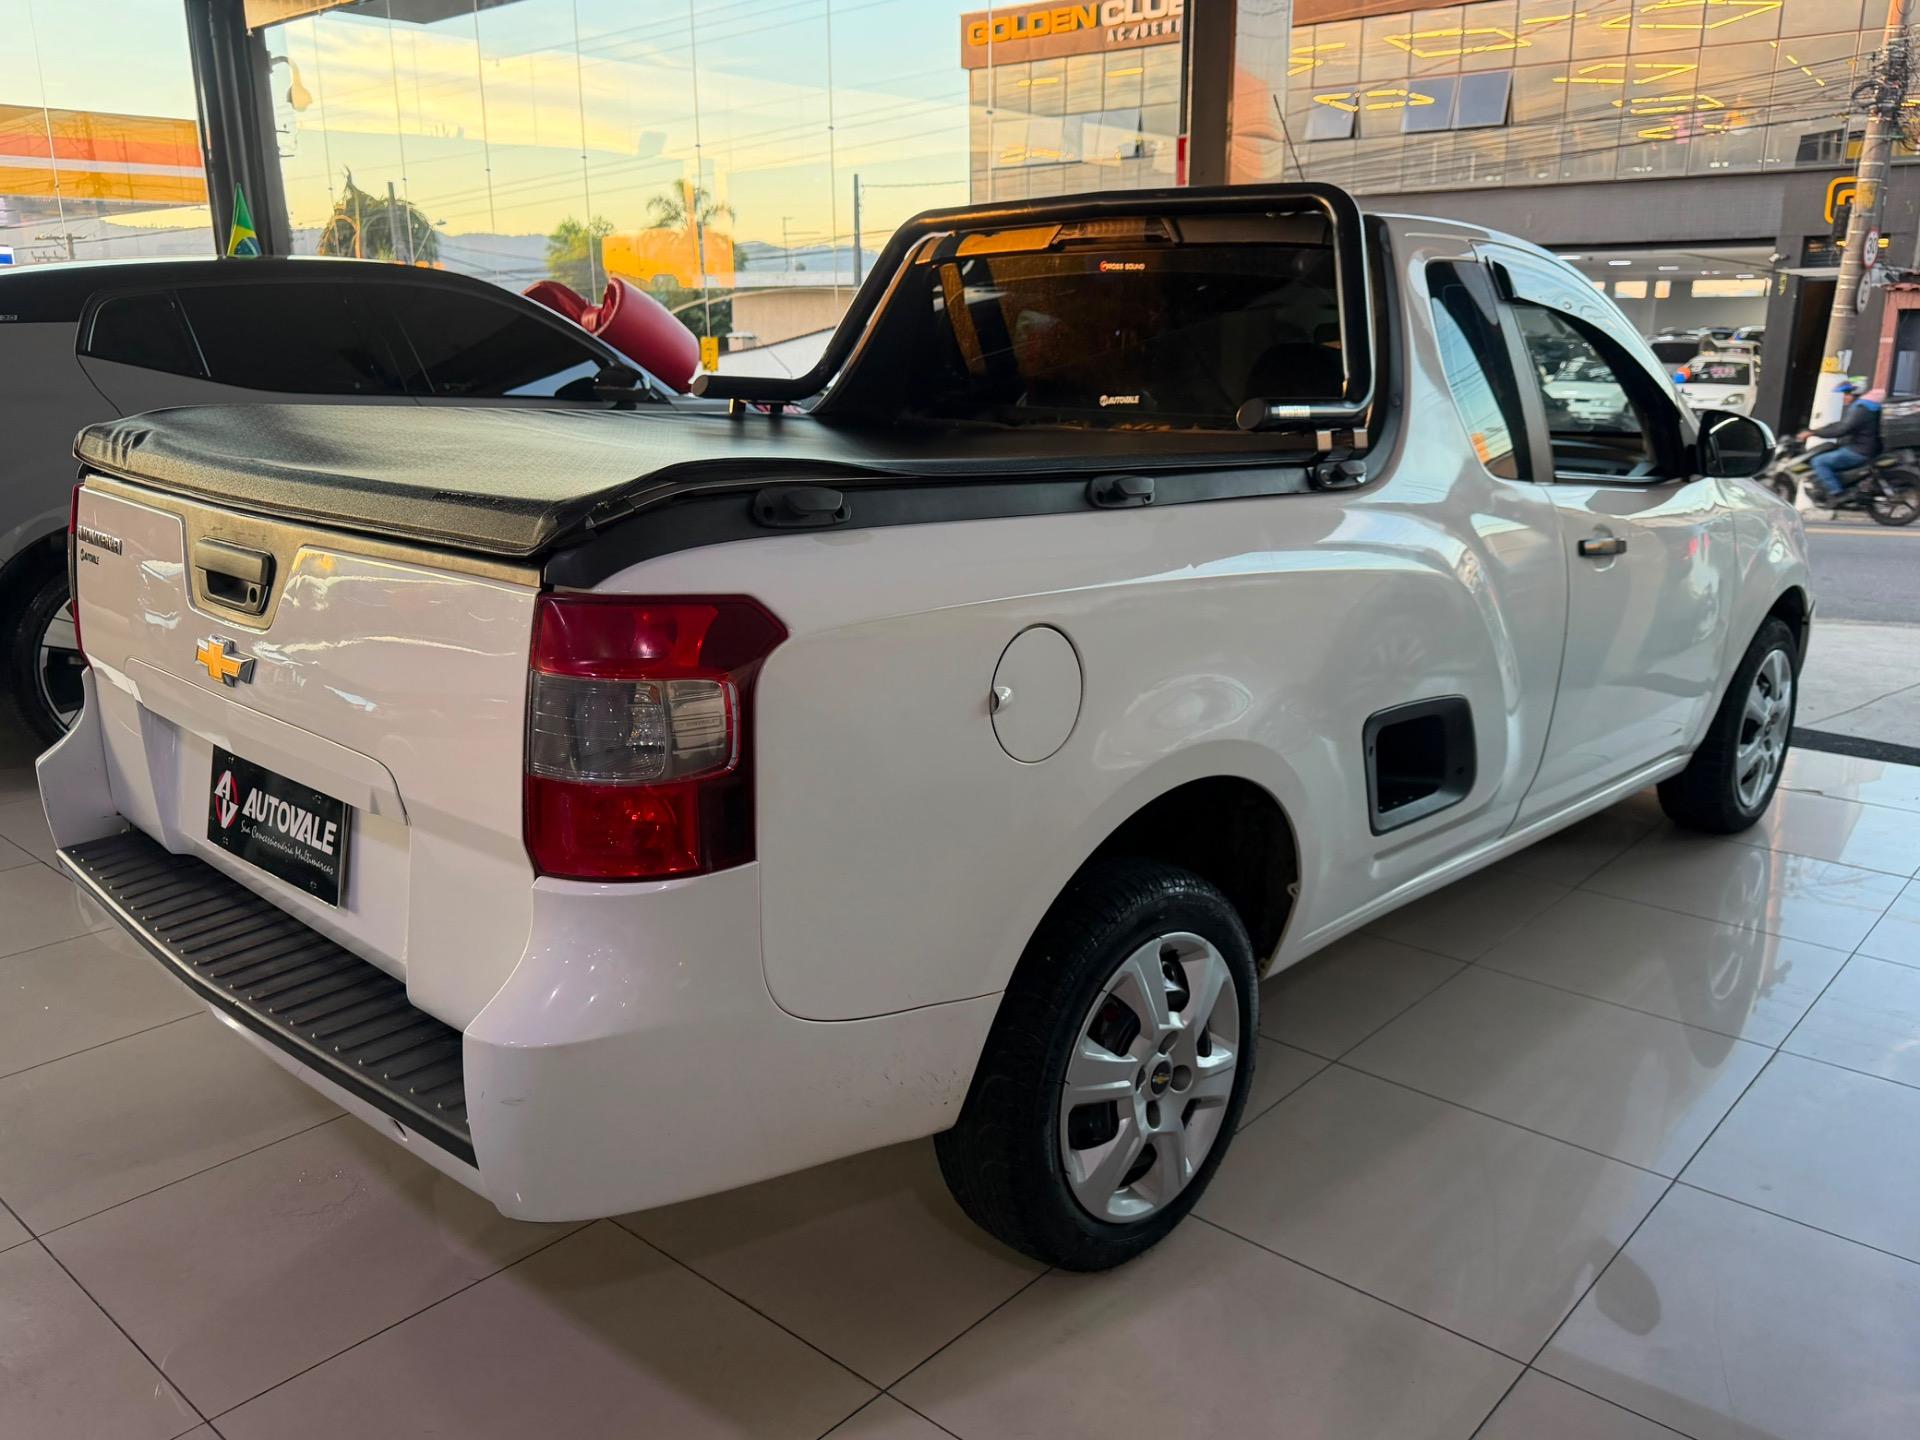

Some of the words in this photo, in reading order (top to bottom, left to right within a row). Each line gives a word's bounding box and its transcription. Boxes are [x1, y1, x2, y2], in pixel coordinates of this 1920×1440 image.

[967, 3, 1099, 46] GOLDEN
[1866, 237, 1877, 254] 30
[241, 787, 338, 856] AUTOVALE
[240, 820, 251, 834] Sua
[294, 845, 334, 876] Multimarcas
